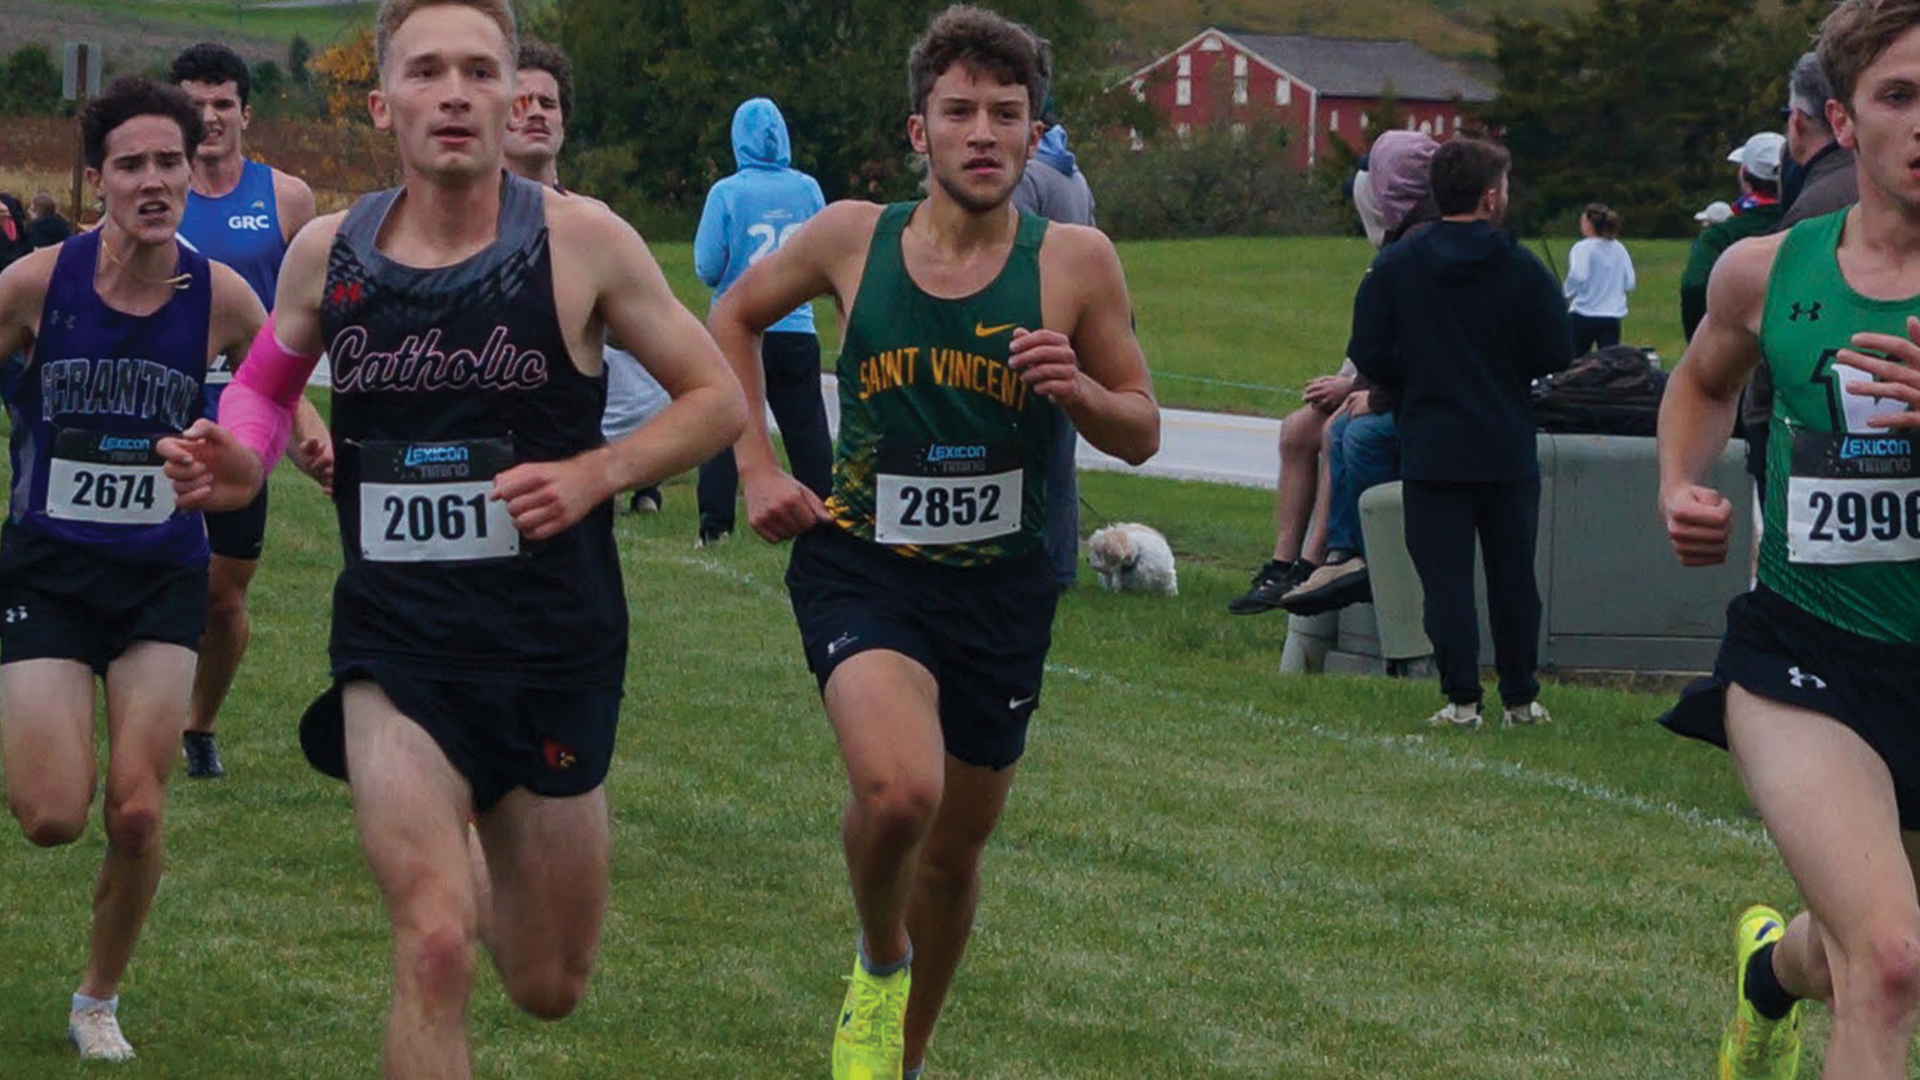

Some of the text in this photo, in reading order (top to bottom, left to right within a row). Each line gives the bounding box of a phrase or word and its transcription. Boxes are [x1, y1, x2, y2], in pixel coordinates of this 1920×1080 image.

[228, 214, 270, 231] GRC
[330, 325, 548, 394] Catholic
[859, 347, 920, 400] SAINT
[71, 470, 155, 510] 2674
[900, 484, 1001, 528] 2852
[384, 494, 488, 542] 2061
